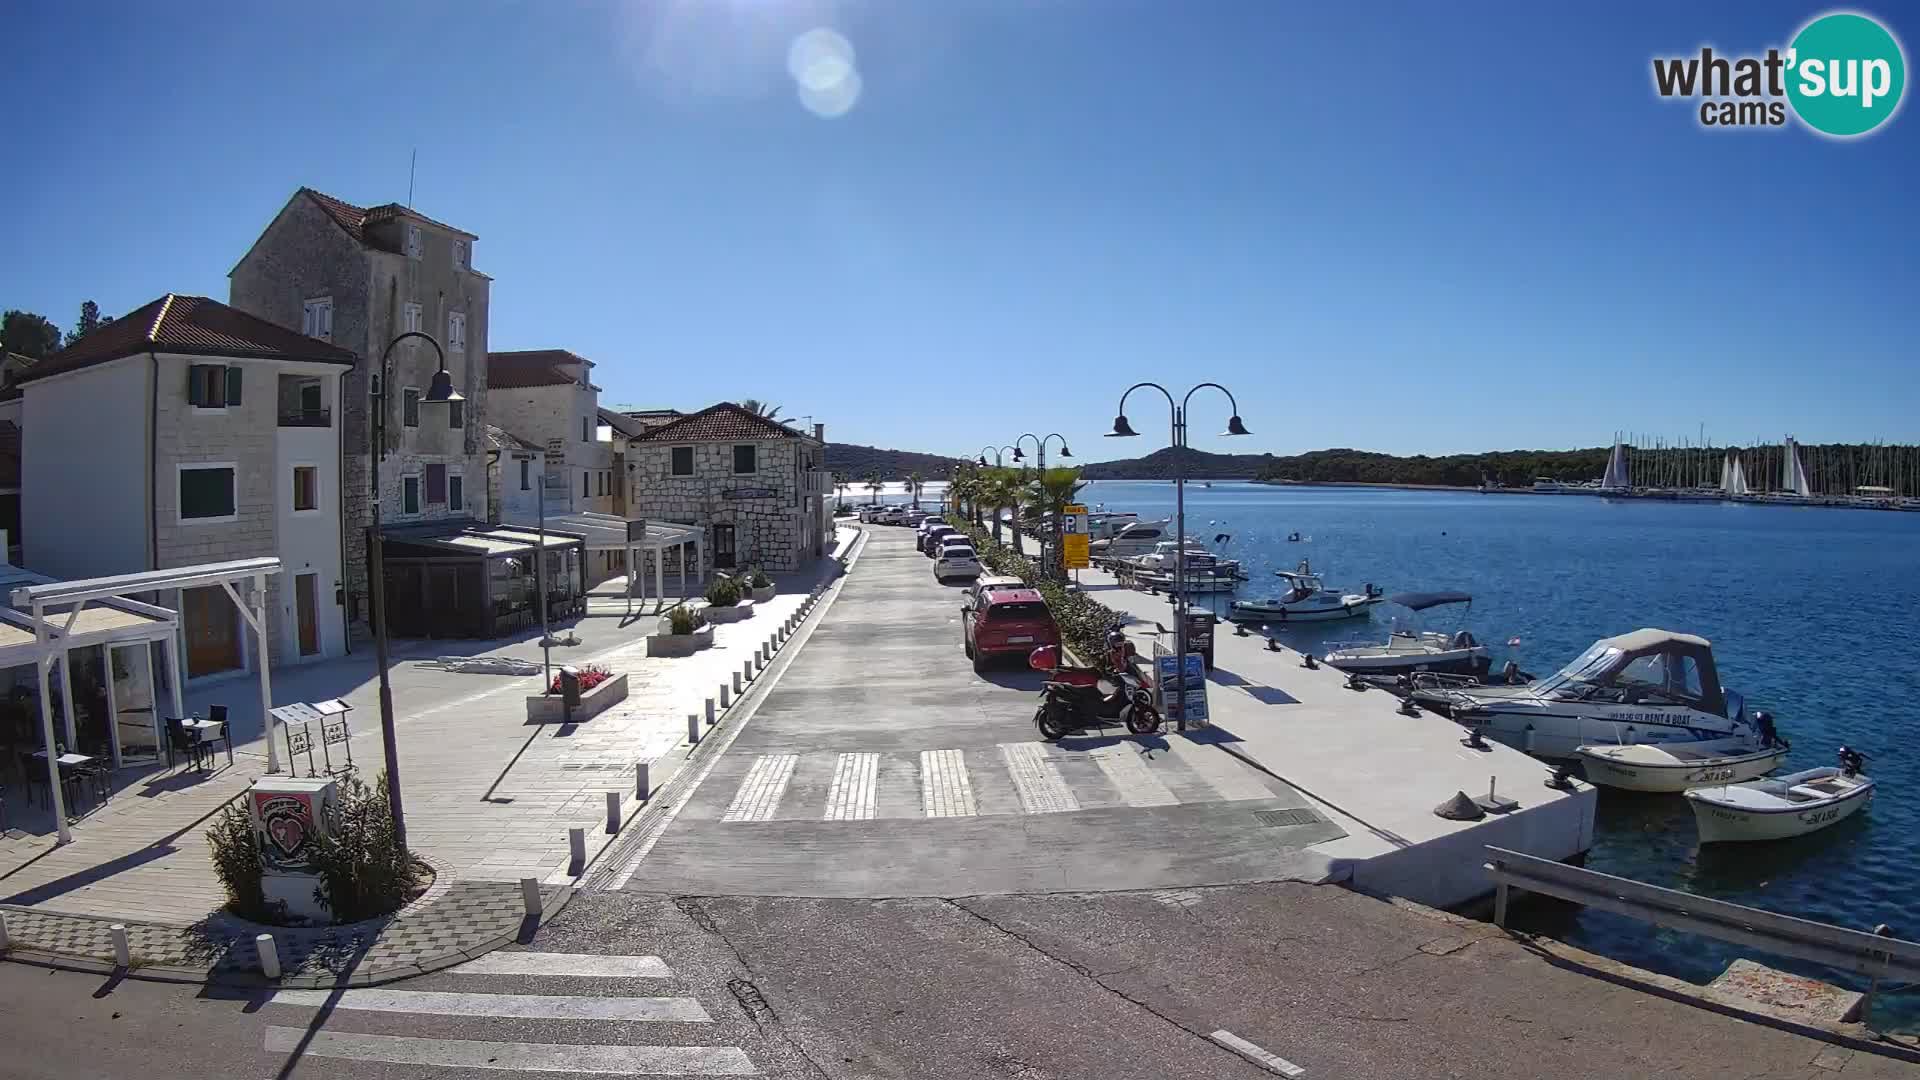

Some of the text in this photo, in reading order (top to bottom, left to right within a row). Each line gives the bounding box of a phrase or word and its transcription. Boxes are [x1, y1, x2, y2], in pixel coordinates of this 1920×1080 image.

[1065, 516, 1075, 531] P
[1645, 713, 1664, 723] RENT
[1672, 715, 1690, 725] BOAT
